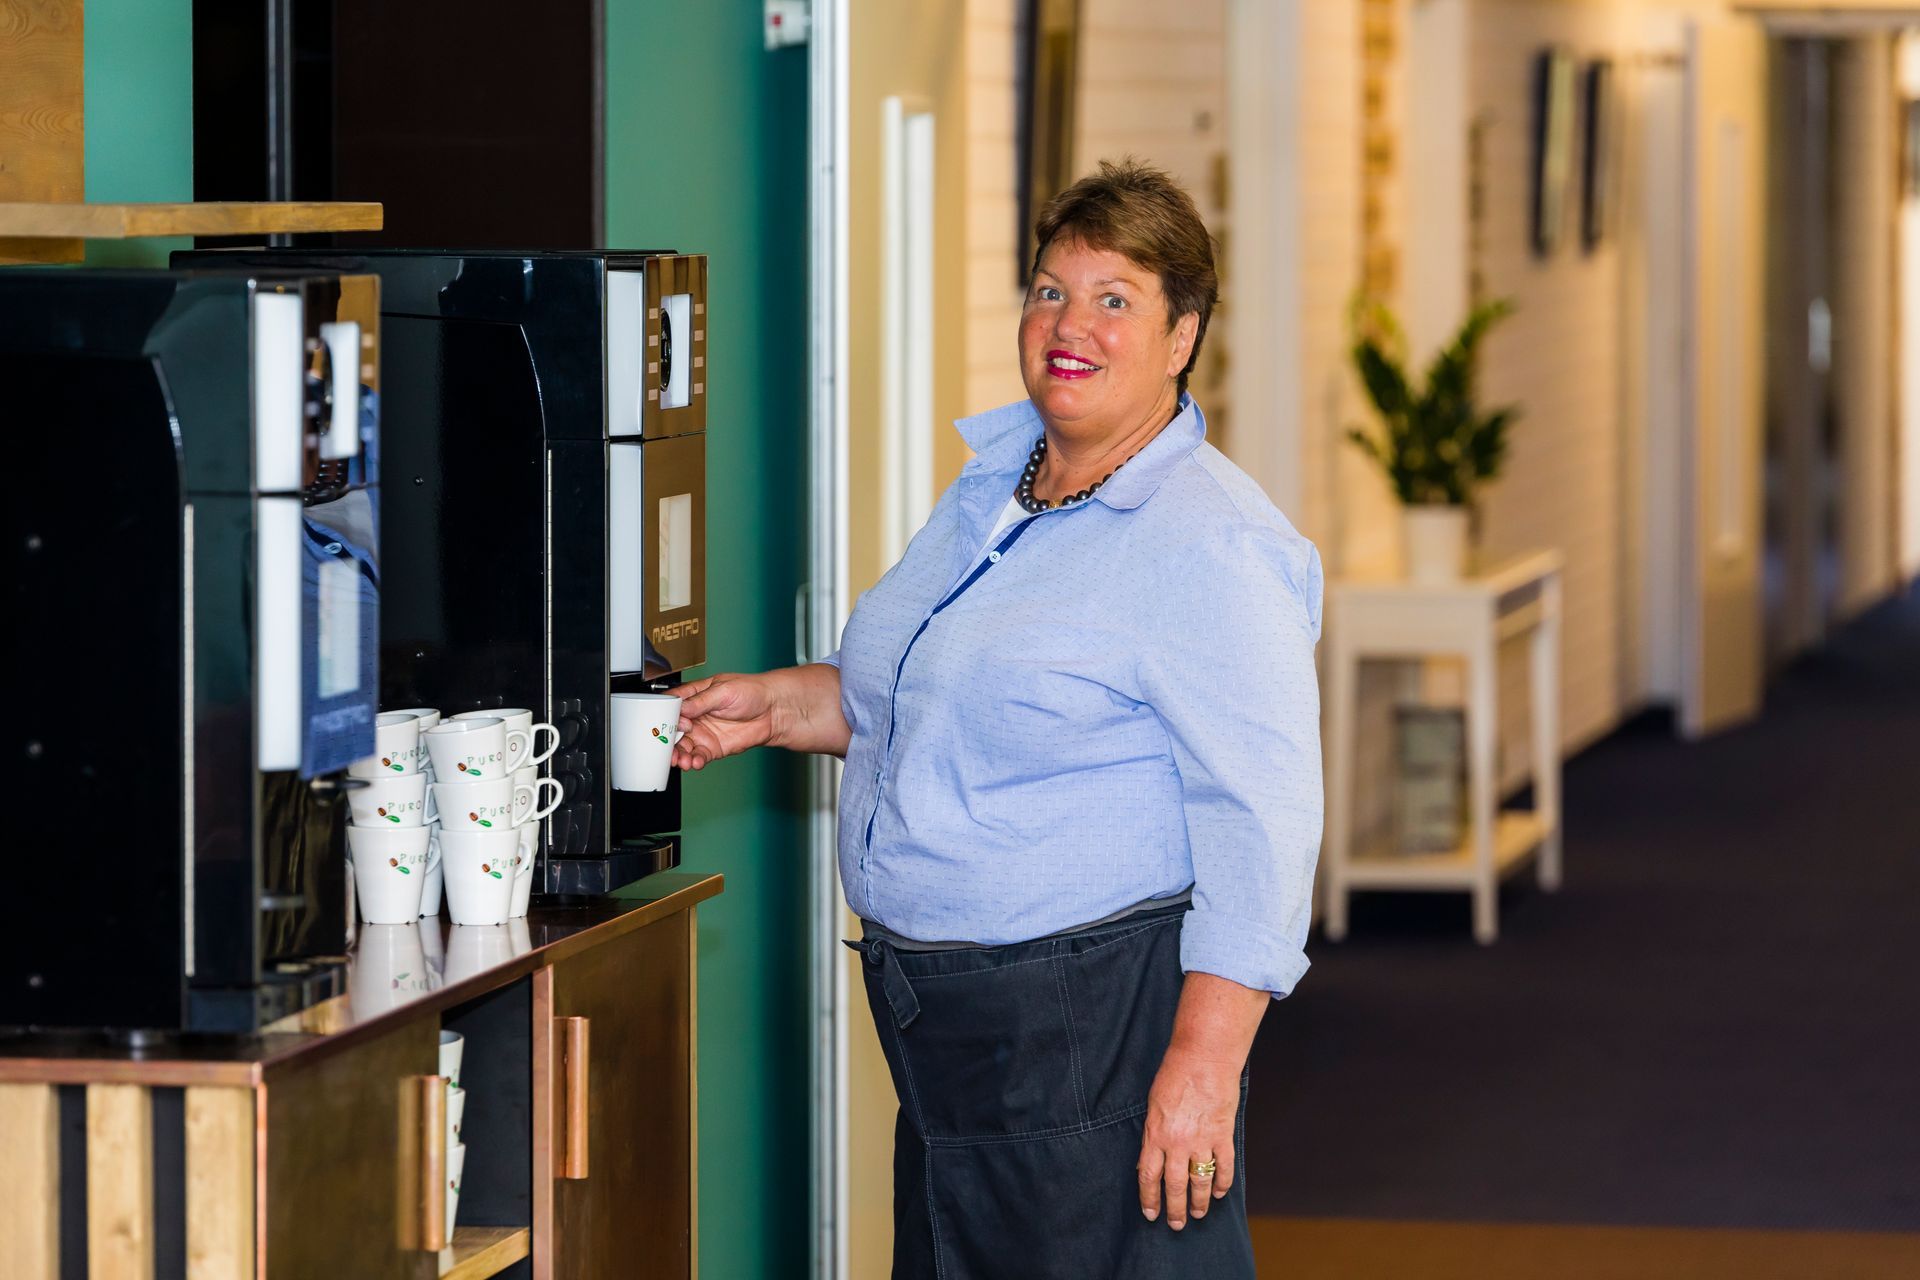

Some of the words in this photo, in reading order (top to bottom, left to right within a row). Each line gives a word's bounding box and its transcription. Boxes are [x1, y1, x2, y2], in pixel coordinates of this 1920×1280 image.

[652, 617, 699, 644] MAESTRO
[467, 751, 503, 766] PURO
[387, 799, 422, 813] PURO
[479, 803, 512, 817] PURO
